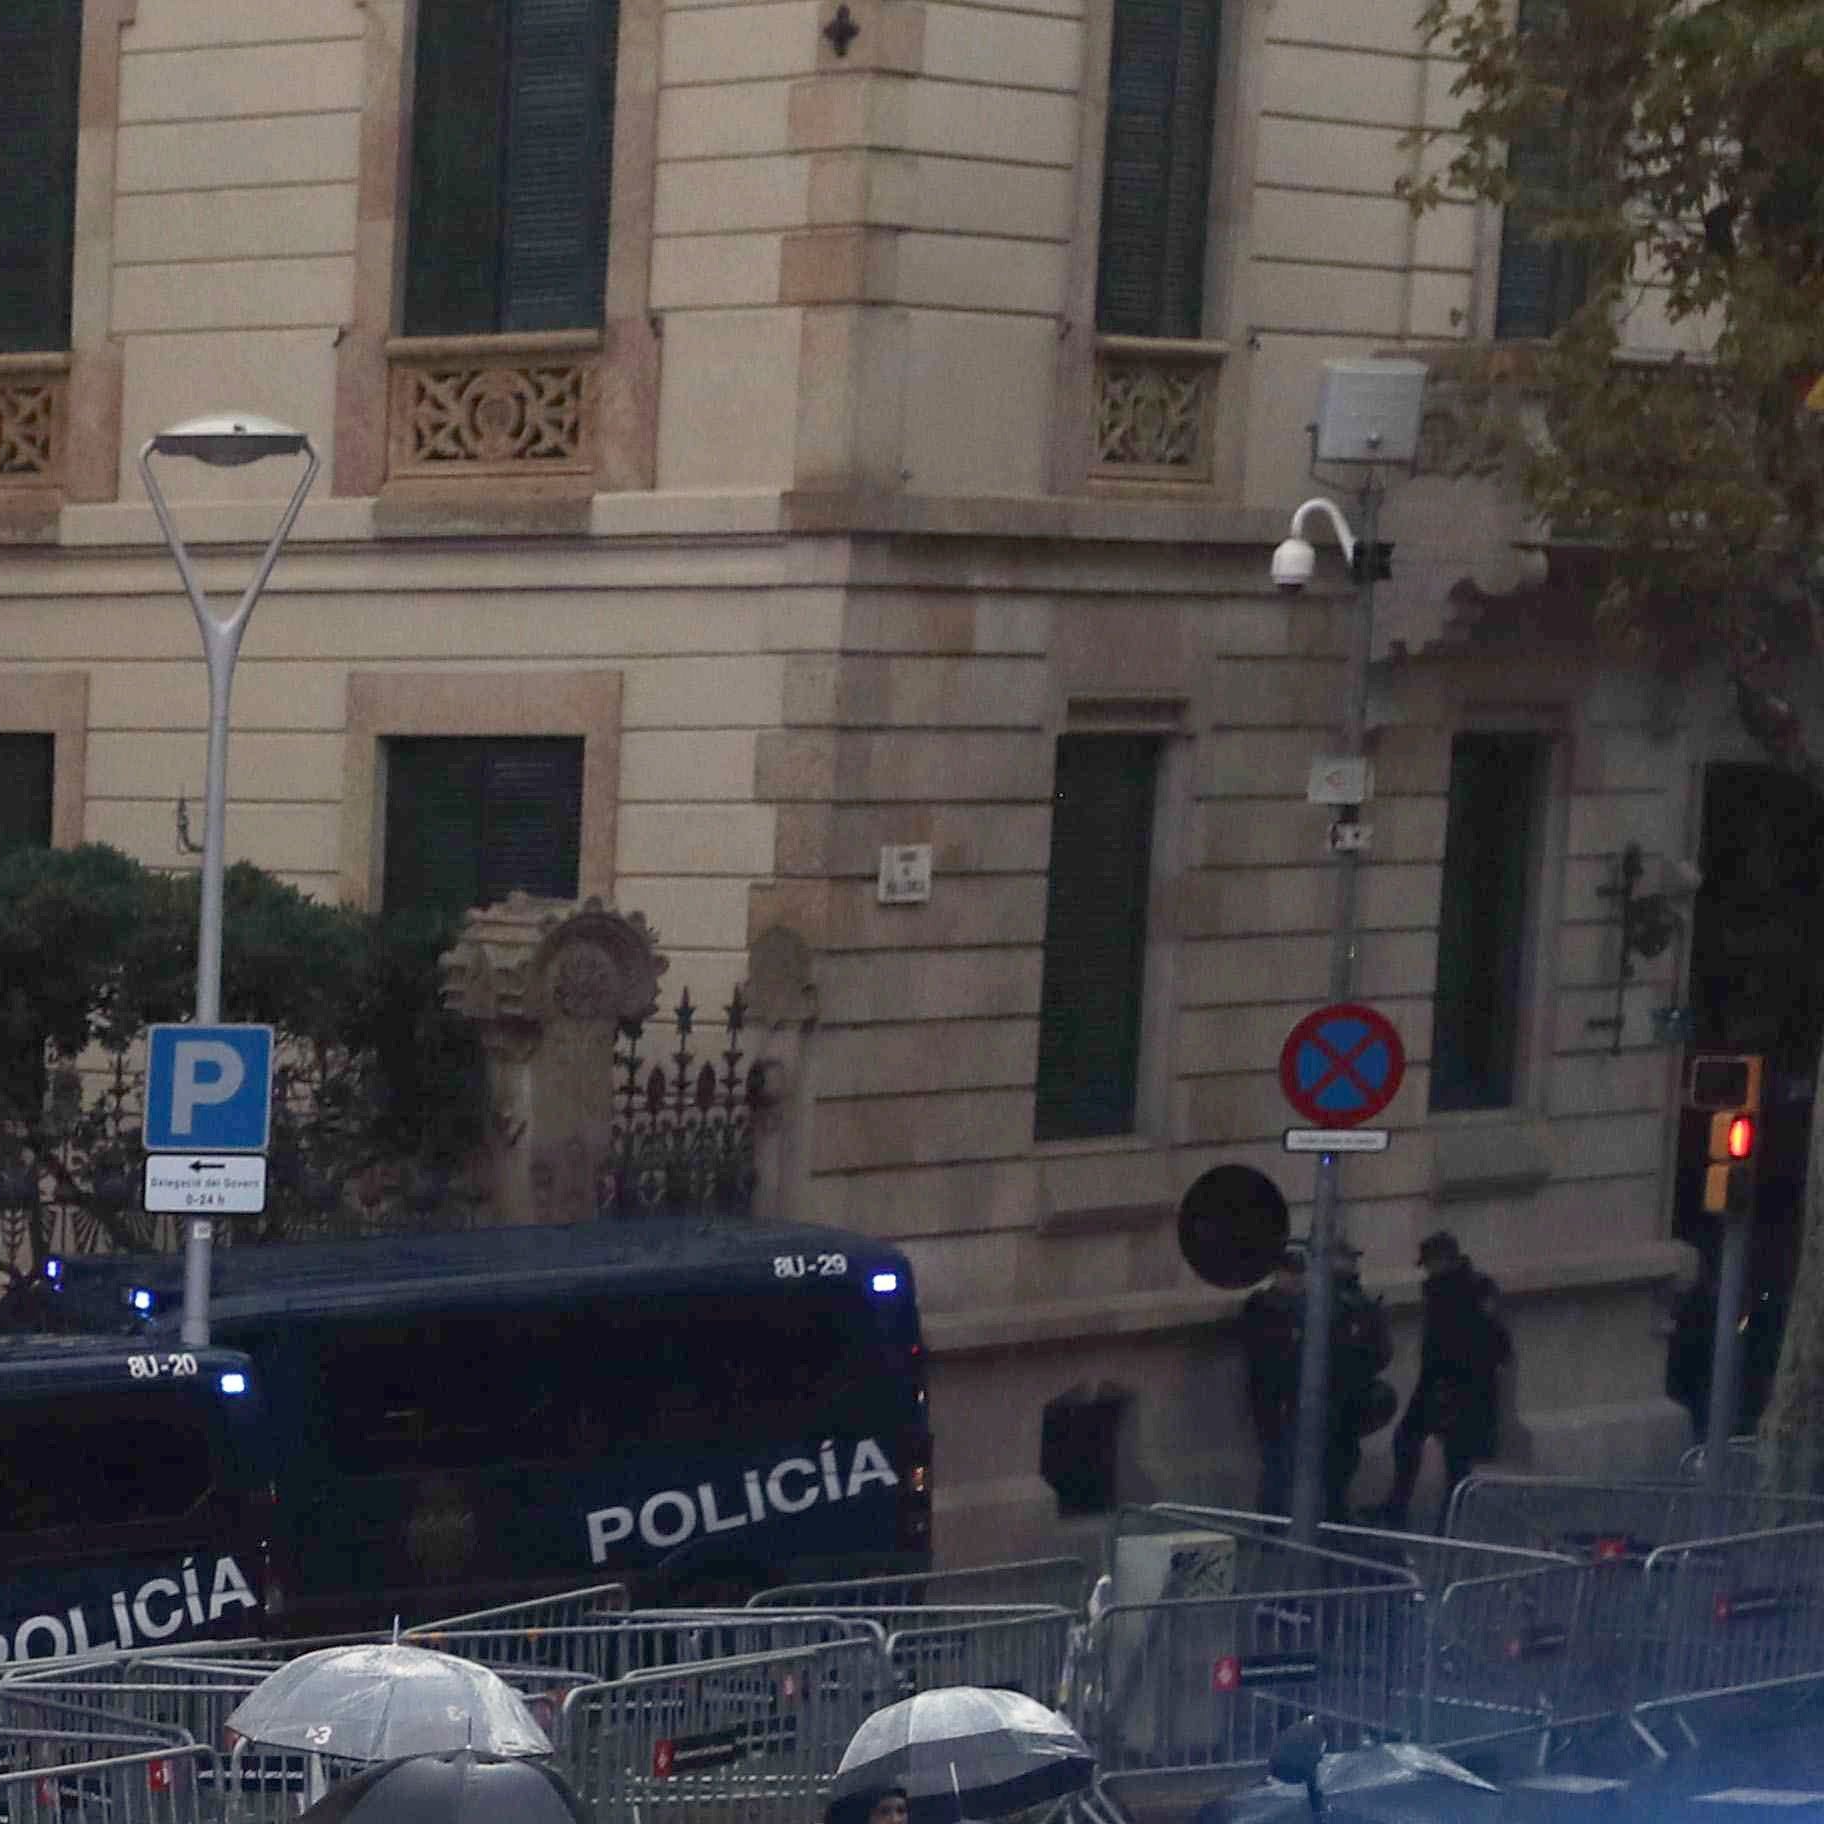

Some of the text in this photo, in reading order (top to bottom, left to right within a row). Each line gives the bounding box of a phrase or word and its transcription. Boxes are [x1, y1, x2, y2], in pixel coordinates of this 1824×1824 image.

[171, 1040, 245, 1135] P
[127, 1353, 198, 1378] 8U-20
[586, 1438, 899, 1564] POLICÍA
